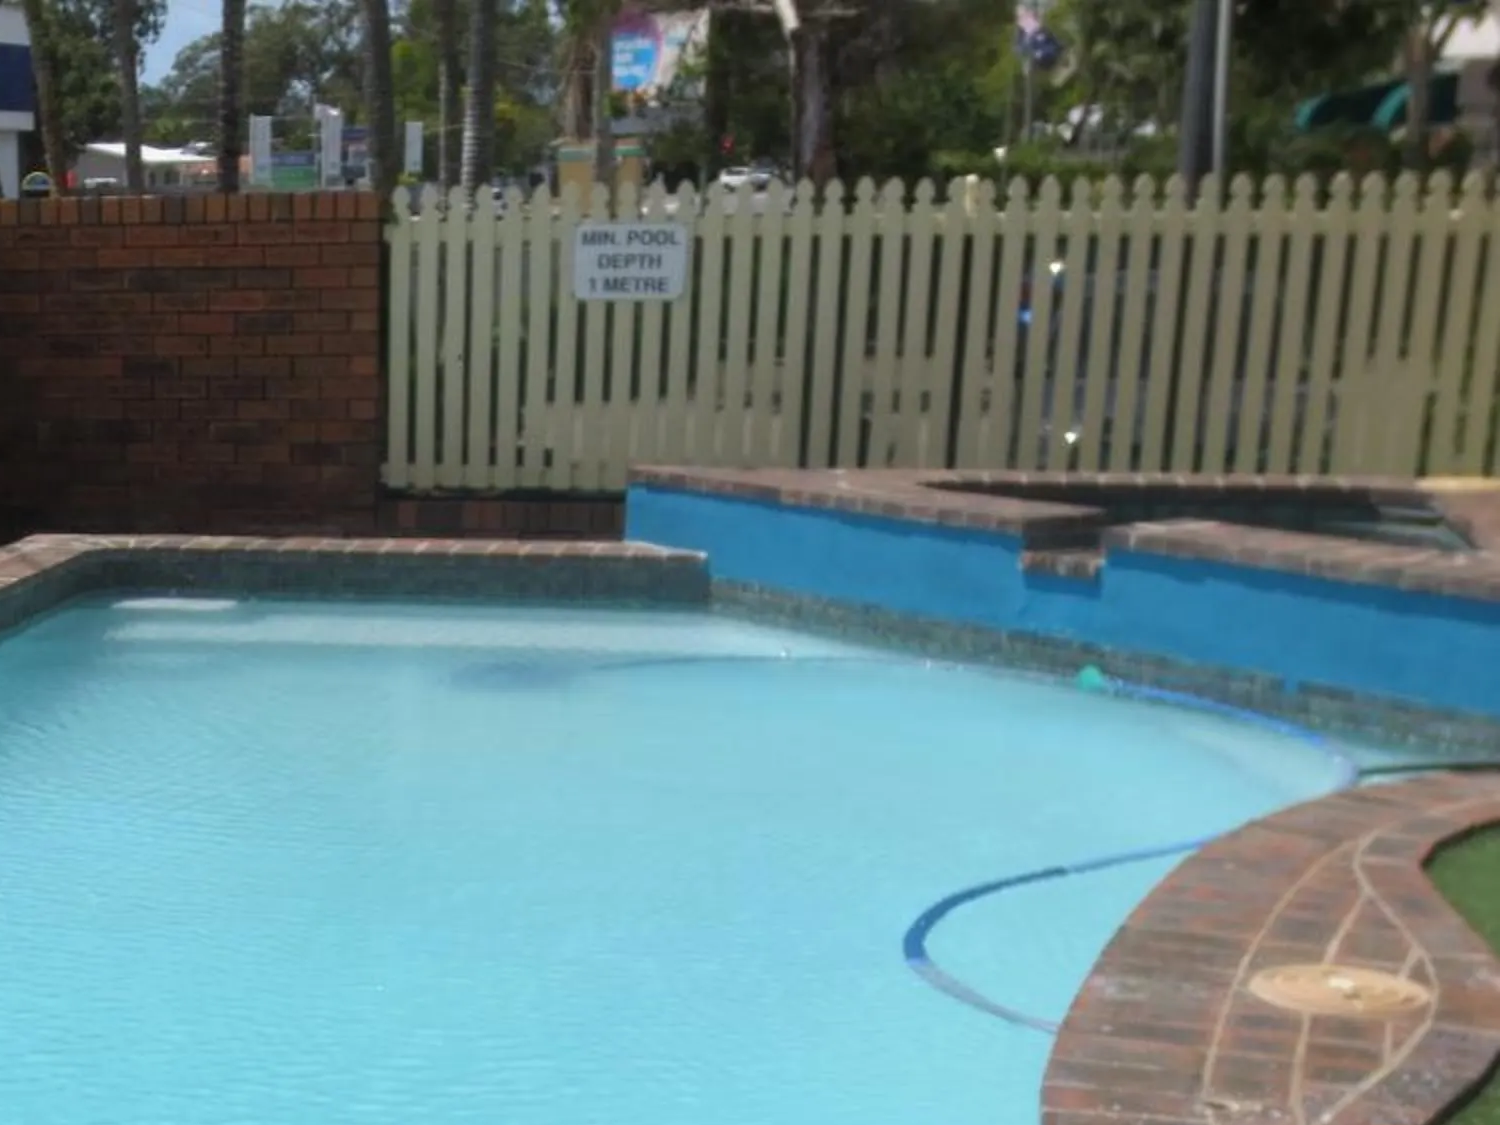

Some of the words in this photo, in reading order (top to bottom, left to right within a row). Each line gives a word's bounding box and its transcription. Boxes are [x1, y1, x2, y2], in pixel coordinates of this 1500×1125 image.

[581, 229, 621, 246] MIN.
[626, 228, 680, 246] POOL
[597, 252, 663, 270] DEPTH
[588, 277, 598, 294] 1
[602, 276, 670, 294] METRE
